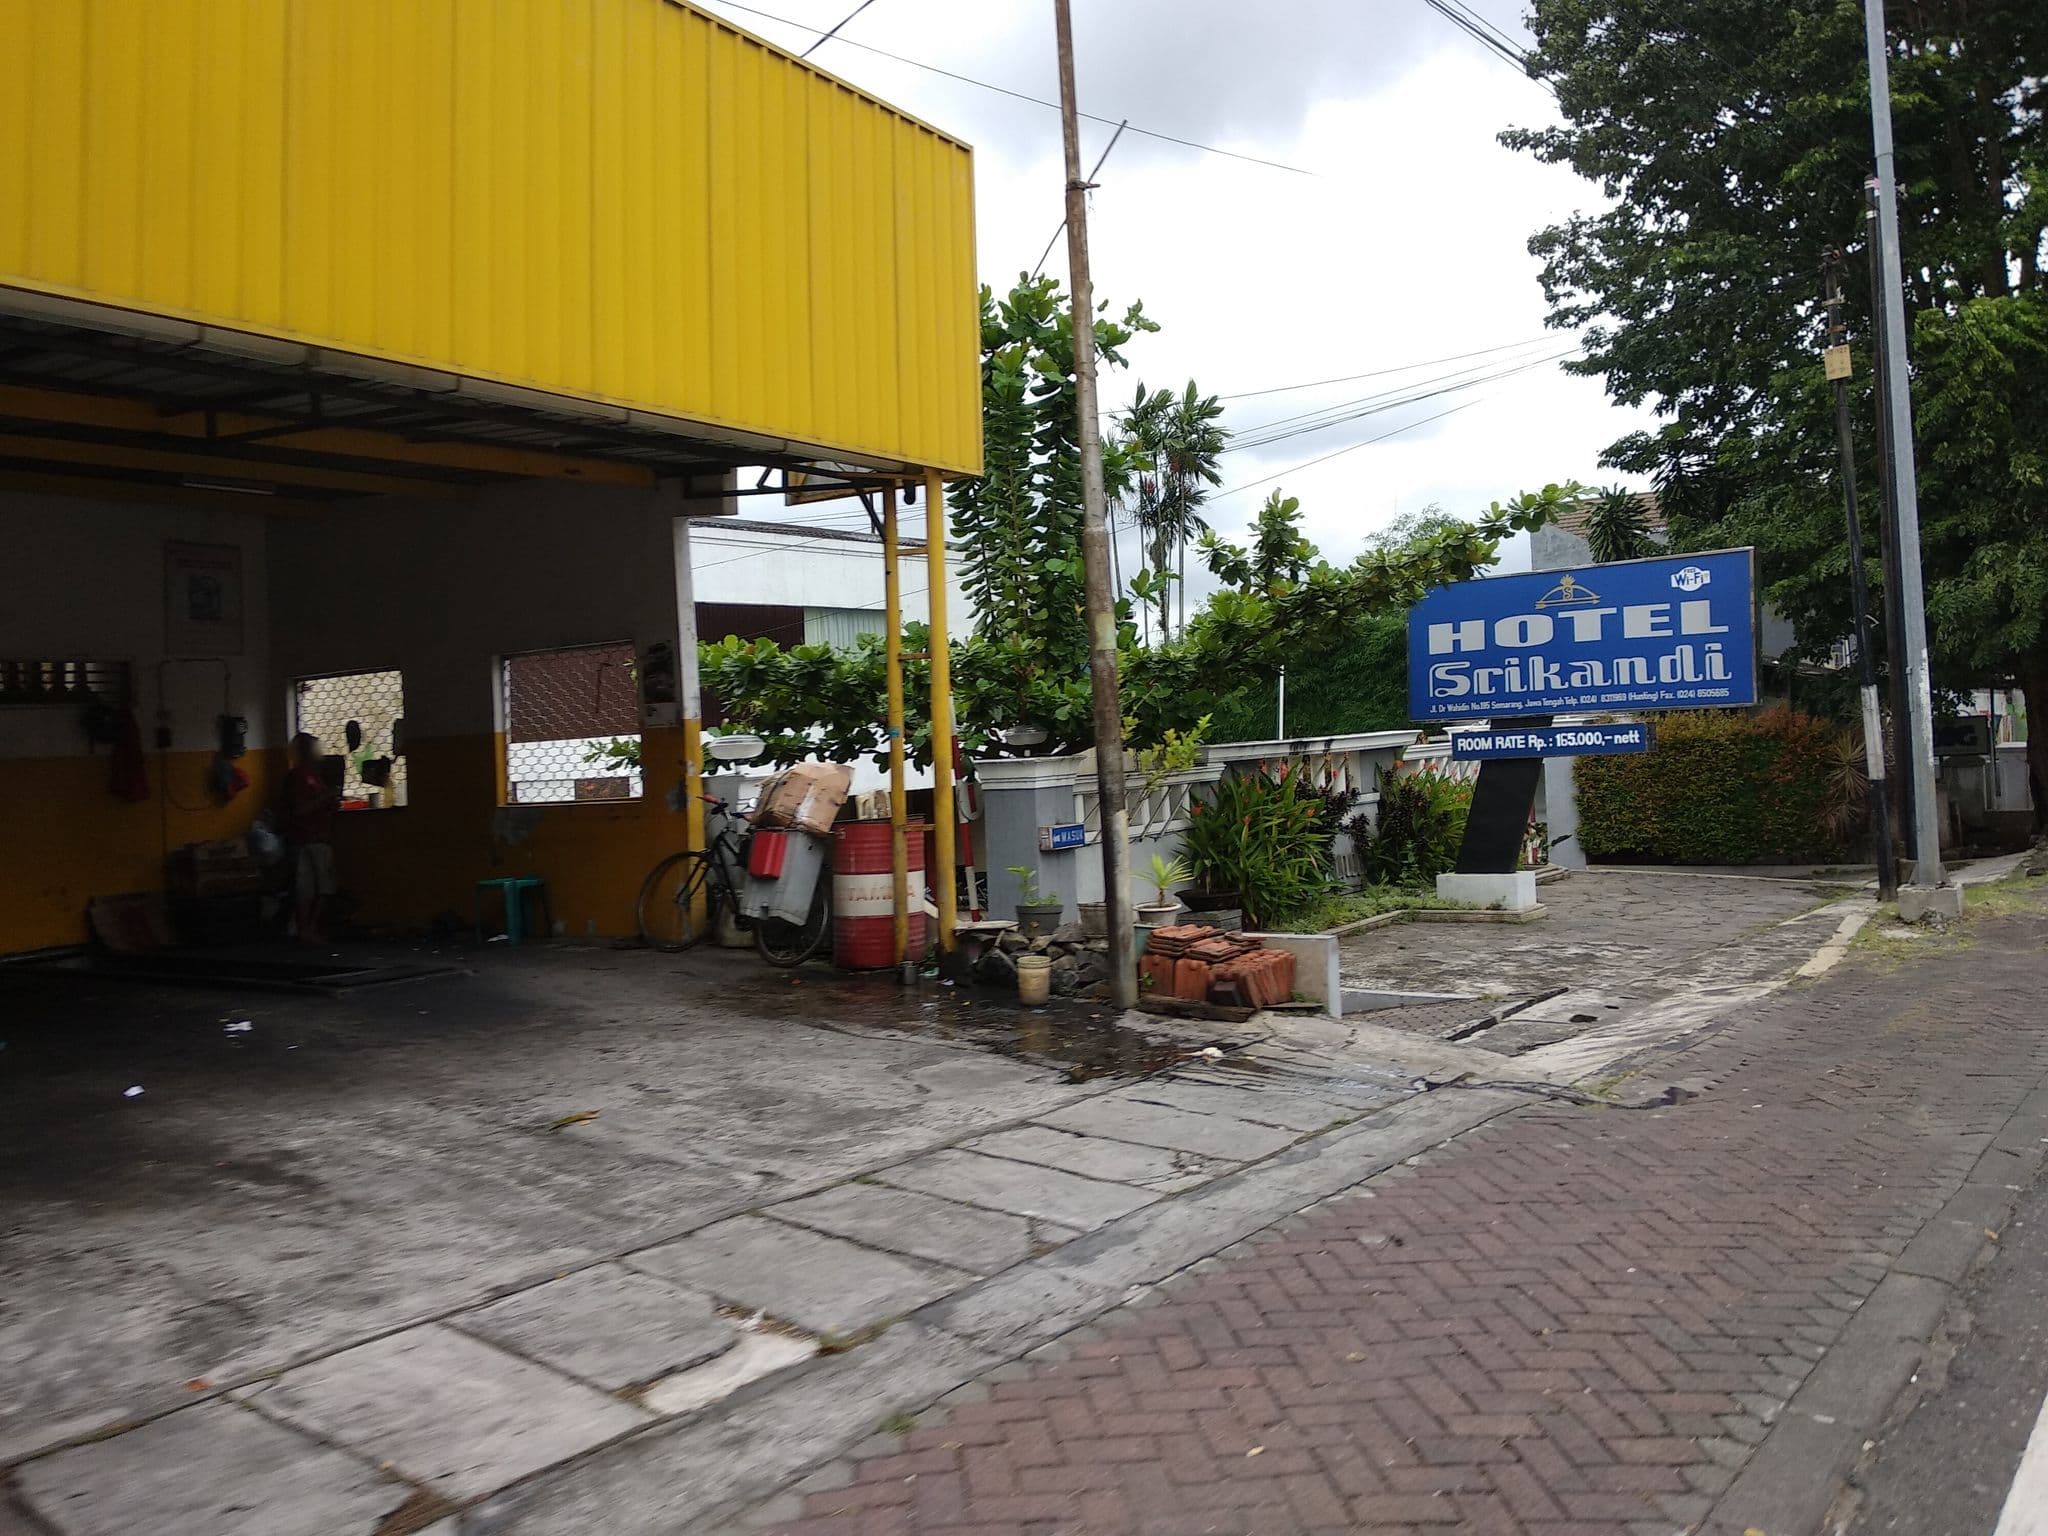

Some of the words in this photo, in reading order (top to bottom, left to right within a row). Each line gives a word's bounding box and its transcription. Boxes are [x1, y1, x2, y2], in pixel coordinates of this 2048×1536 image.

[1674, 572, 1703, 585] Wi-Fi
[1428, 600, 1729, 655] HOTEL
[1429, 642, 1732, 698] Srikandi
[1457, 736, 1493, 751] ROOM
[1495, 735, 1525, 749] RATE
[1614, 730, 1640, 744] nett
